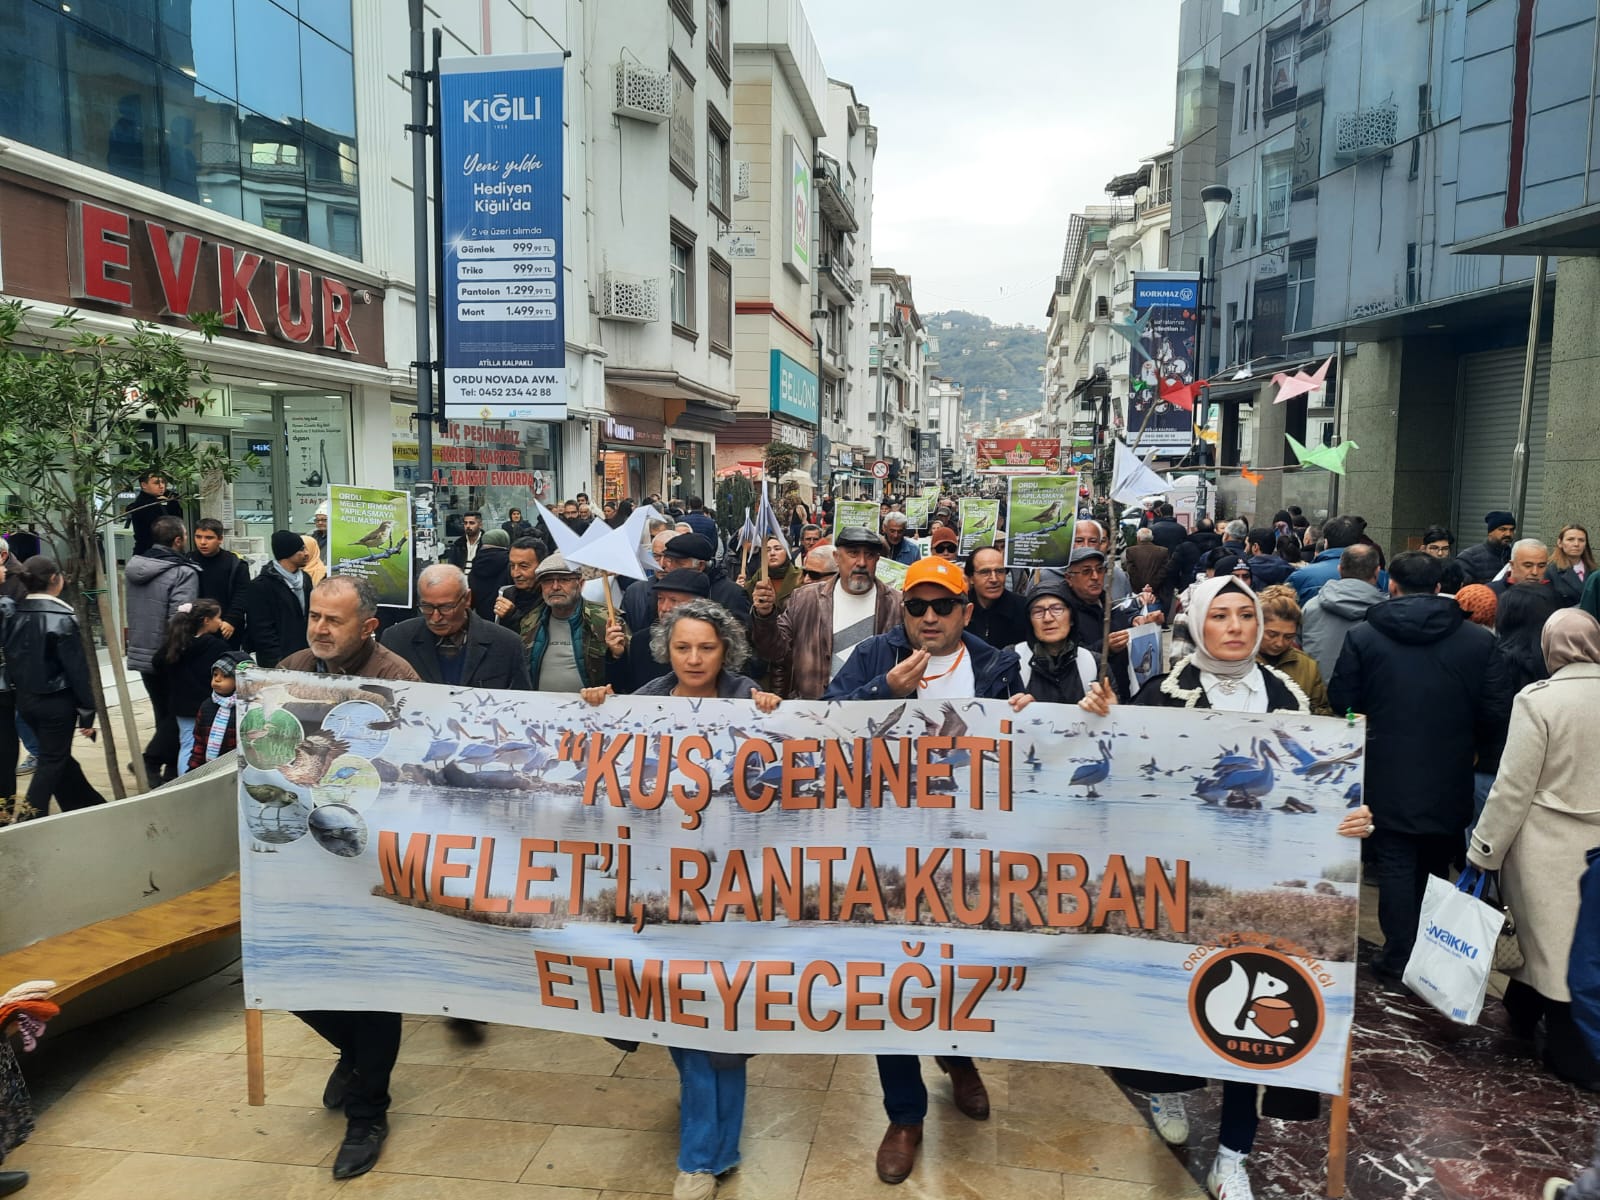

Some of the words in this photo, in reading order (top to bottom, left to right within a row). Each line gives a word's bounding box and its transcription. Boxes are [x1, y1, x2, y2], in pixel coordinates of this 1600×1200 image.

[463, 153, 499, 176] Yeni
[473, 181, 532, 197] Hediyen
[471, 228, 477, 236] 2
[490, 227, 510, 235] üzeri
[512, 227, 542, 235] alımda
[461, 245, 495, 254] Gömlek
[461, 266, 483, 275] Triko
[73, 200, 359, 355] EVKUR
[461, 288, 500, 296] Pantolon
[1140, 290, 1179, 298] KORKMAZ
[461, 308, 485, 316] Mont
[452, 375, 483, 384] ORDU
[485, 375, 530, 384] NOVADA
[532, 375, 559, 384] AVM.
[461, 388, 477, 397] Tel:
[479, 388, 503, 397] 0452
[505, 388, 524, 397] 234
[525, 388, 538, 397] 42
[540, 388, 552, 397] 88
[781, 368, 816, 409] BELLONA
[339, 493, 362, 501] ORDU
[733, 719, 1013, 813] CENNETİ
[668, 845, 888, 924] RANTA
[903, 846, 1190, 934] KURBAN
[1226, 1039, 1288, 1057] ORÇEV
